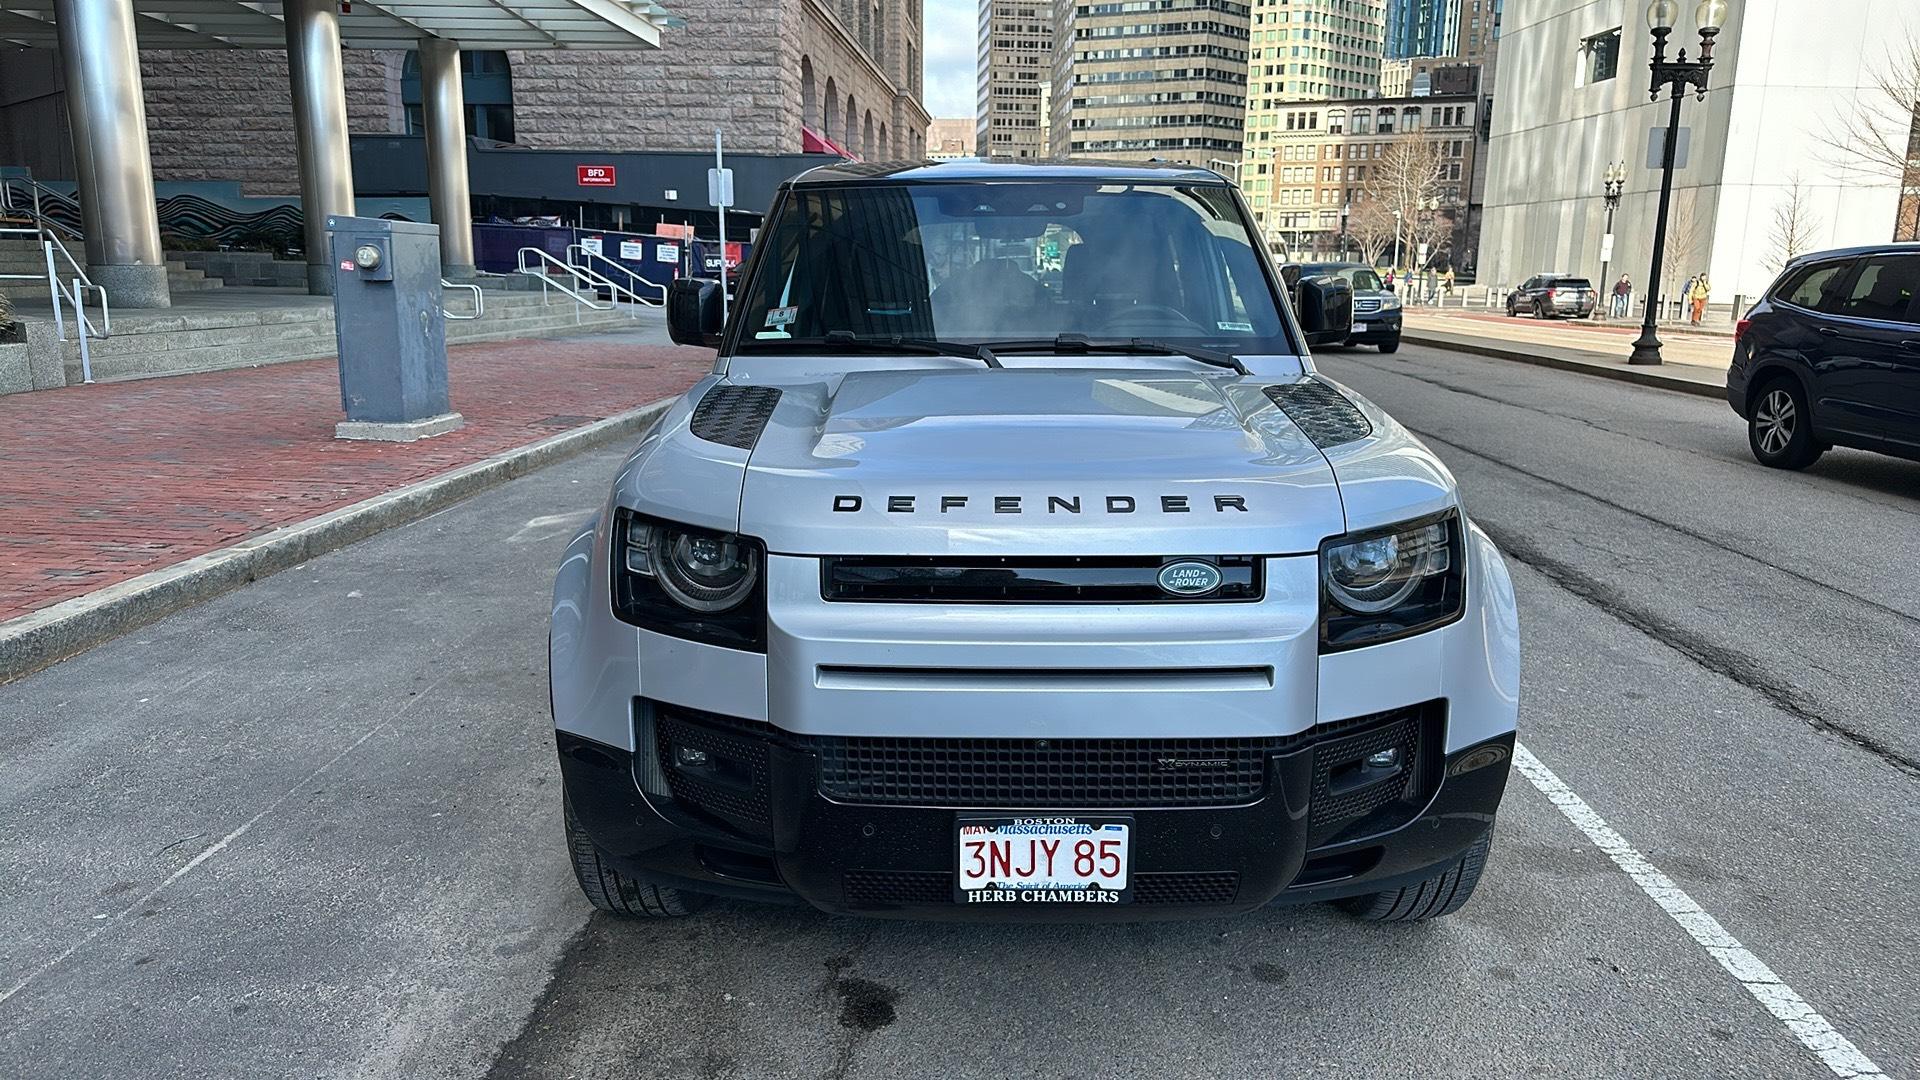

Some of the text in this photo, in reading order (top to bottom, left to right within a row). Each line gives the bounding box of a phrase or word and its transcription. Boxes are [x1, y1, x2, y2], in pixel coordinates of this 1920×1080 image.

[587, 168, 605, 177] BFD
[705, 259, 736, 268] SUFLK
[832, 494, 1249, 514] DEFENDER
[962, 825, 987, 835] MAY
[995, 824, 1093, 835] Massachusetts
[965, 839, 1121, 878] 3NJY 85
[968, 890, 1119, 903] HERB CHAMBERS
